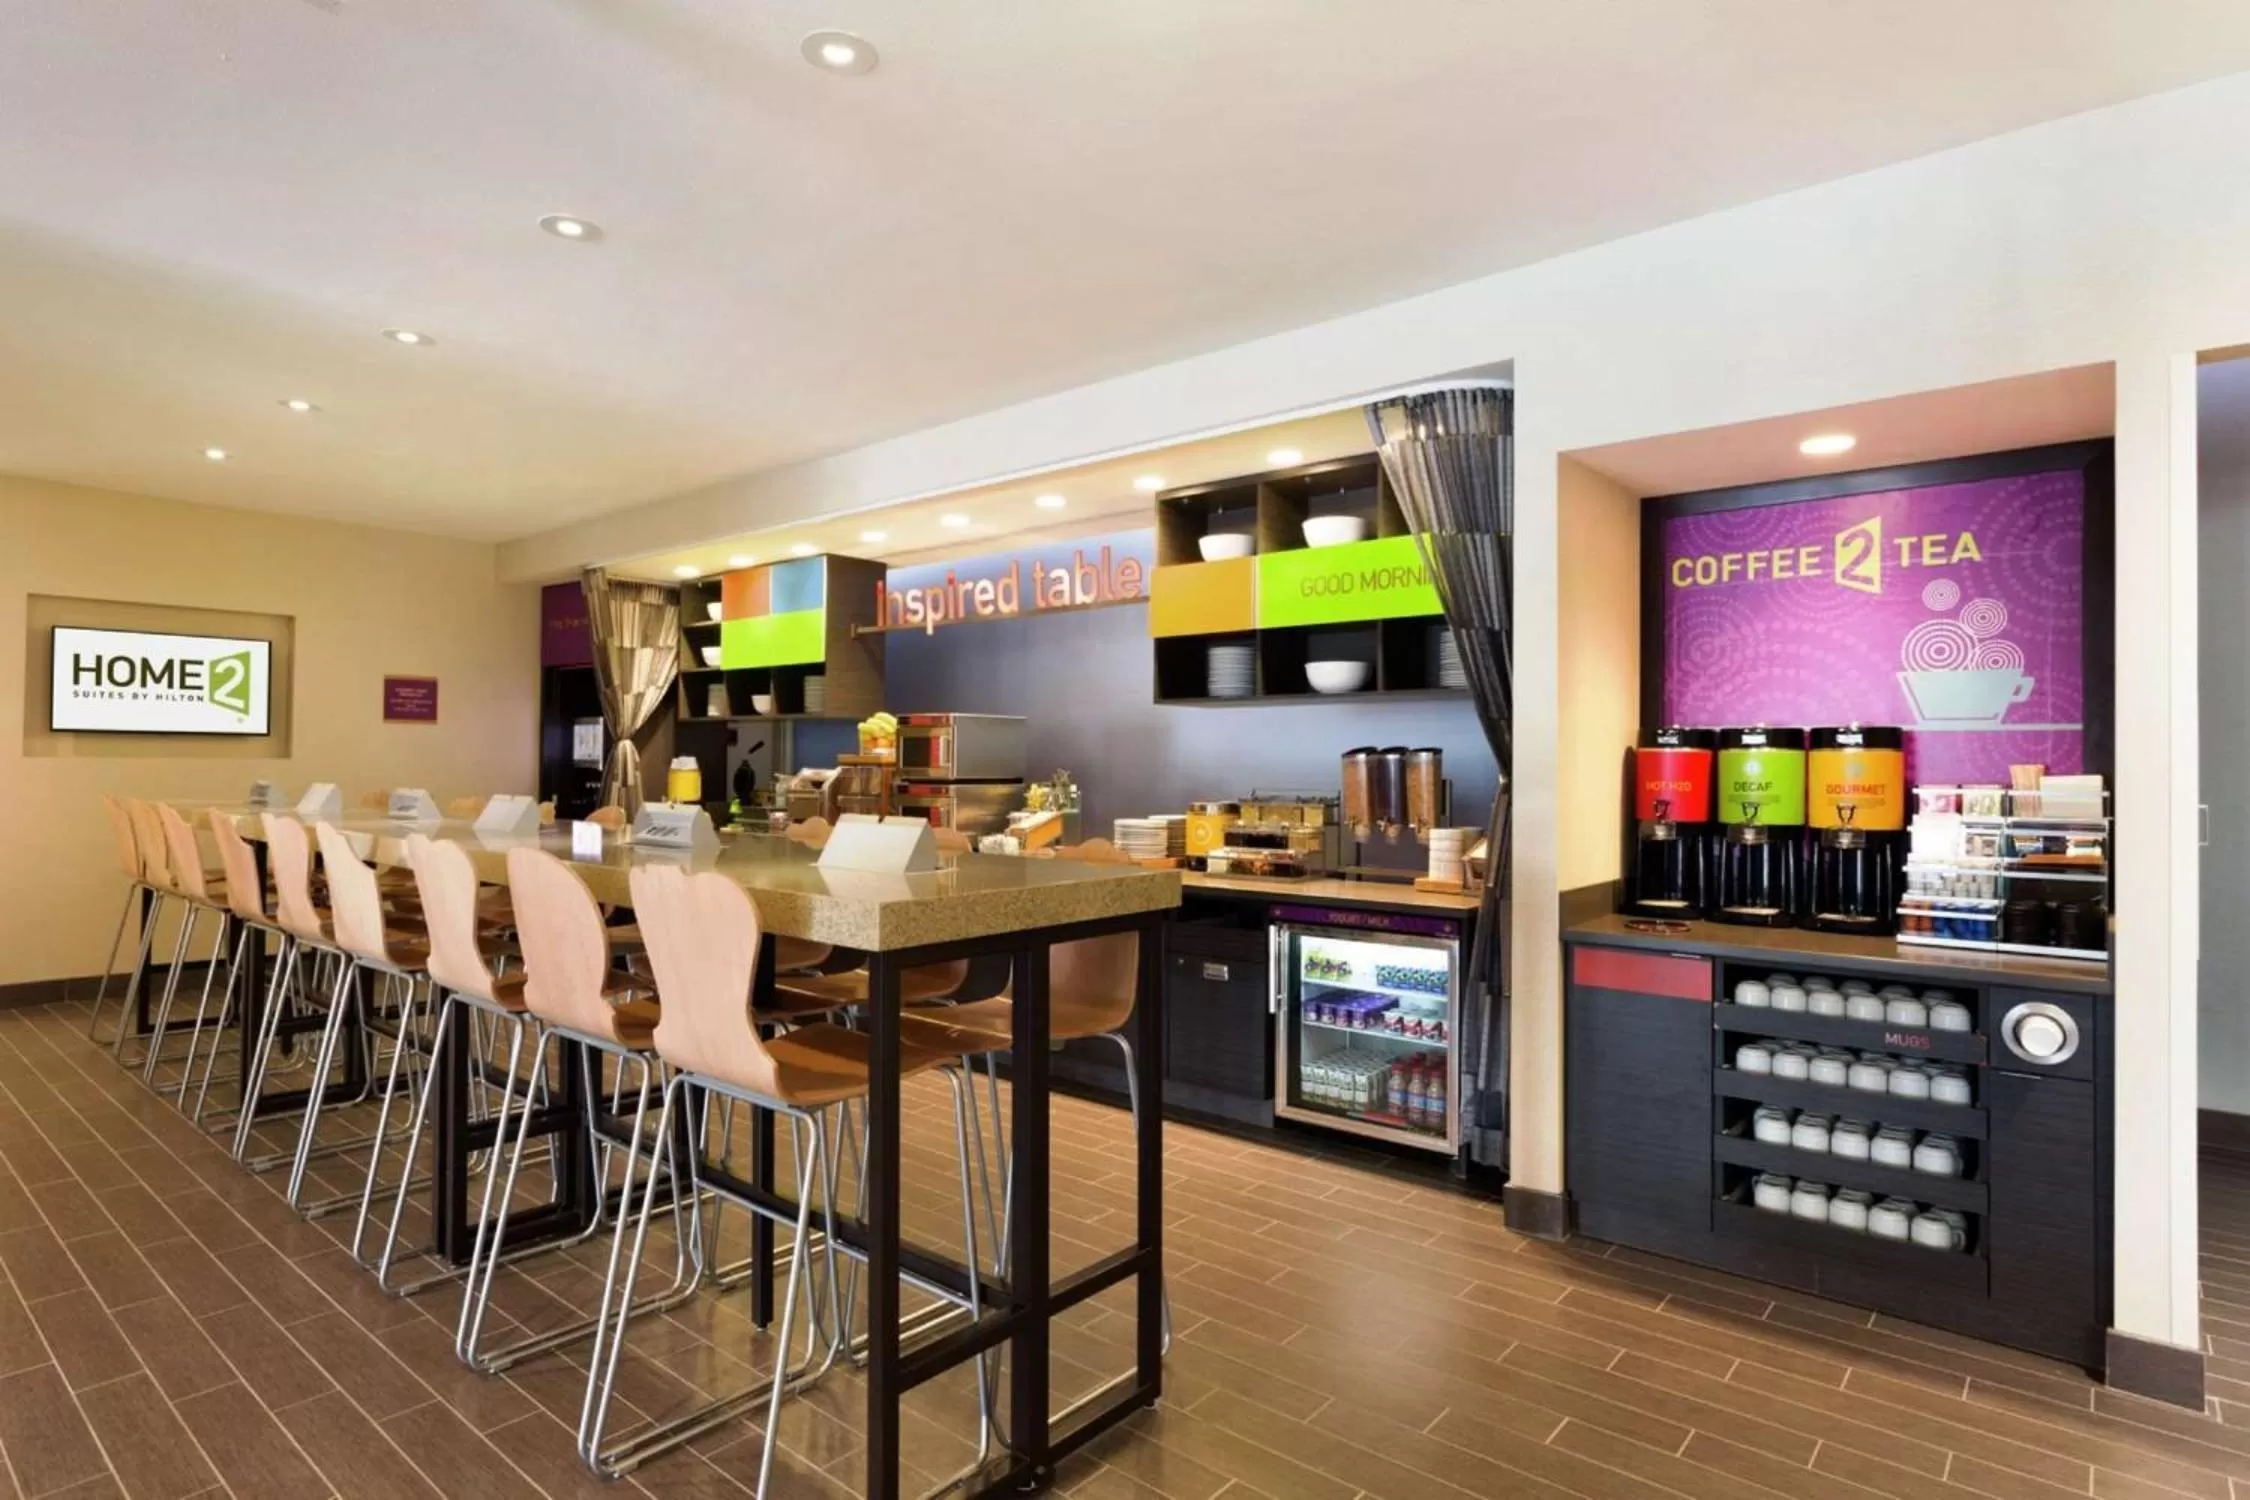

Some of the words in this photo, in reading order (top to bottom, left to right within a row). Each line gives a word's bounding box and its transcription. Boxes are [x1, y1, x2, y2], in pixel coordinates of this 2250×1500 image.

[1671, 545, 1823, 588] COFFEE
[1840, 527, 1875, 586] 2
[1893, 531, 1983, 568] TEA
[1301, 572, 1354, 597] GOOD
[1360, 564, 1432, 592] MORNI
[876, 560, 1021, 635] inspired
[1032, 545, 1142, 609] table
[73, 690, 124, 700] SUITES
[132, 692, 148, 700] BY
[156, 693, 204, 702] HILTON
[1733, 780, 1773, 792] DECAF
[1825, 783, 1886, 796] GOURMET
[1885, 1031, 1930, 1049] MUGS
